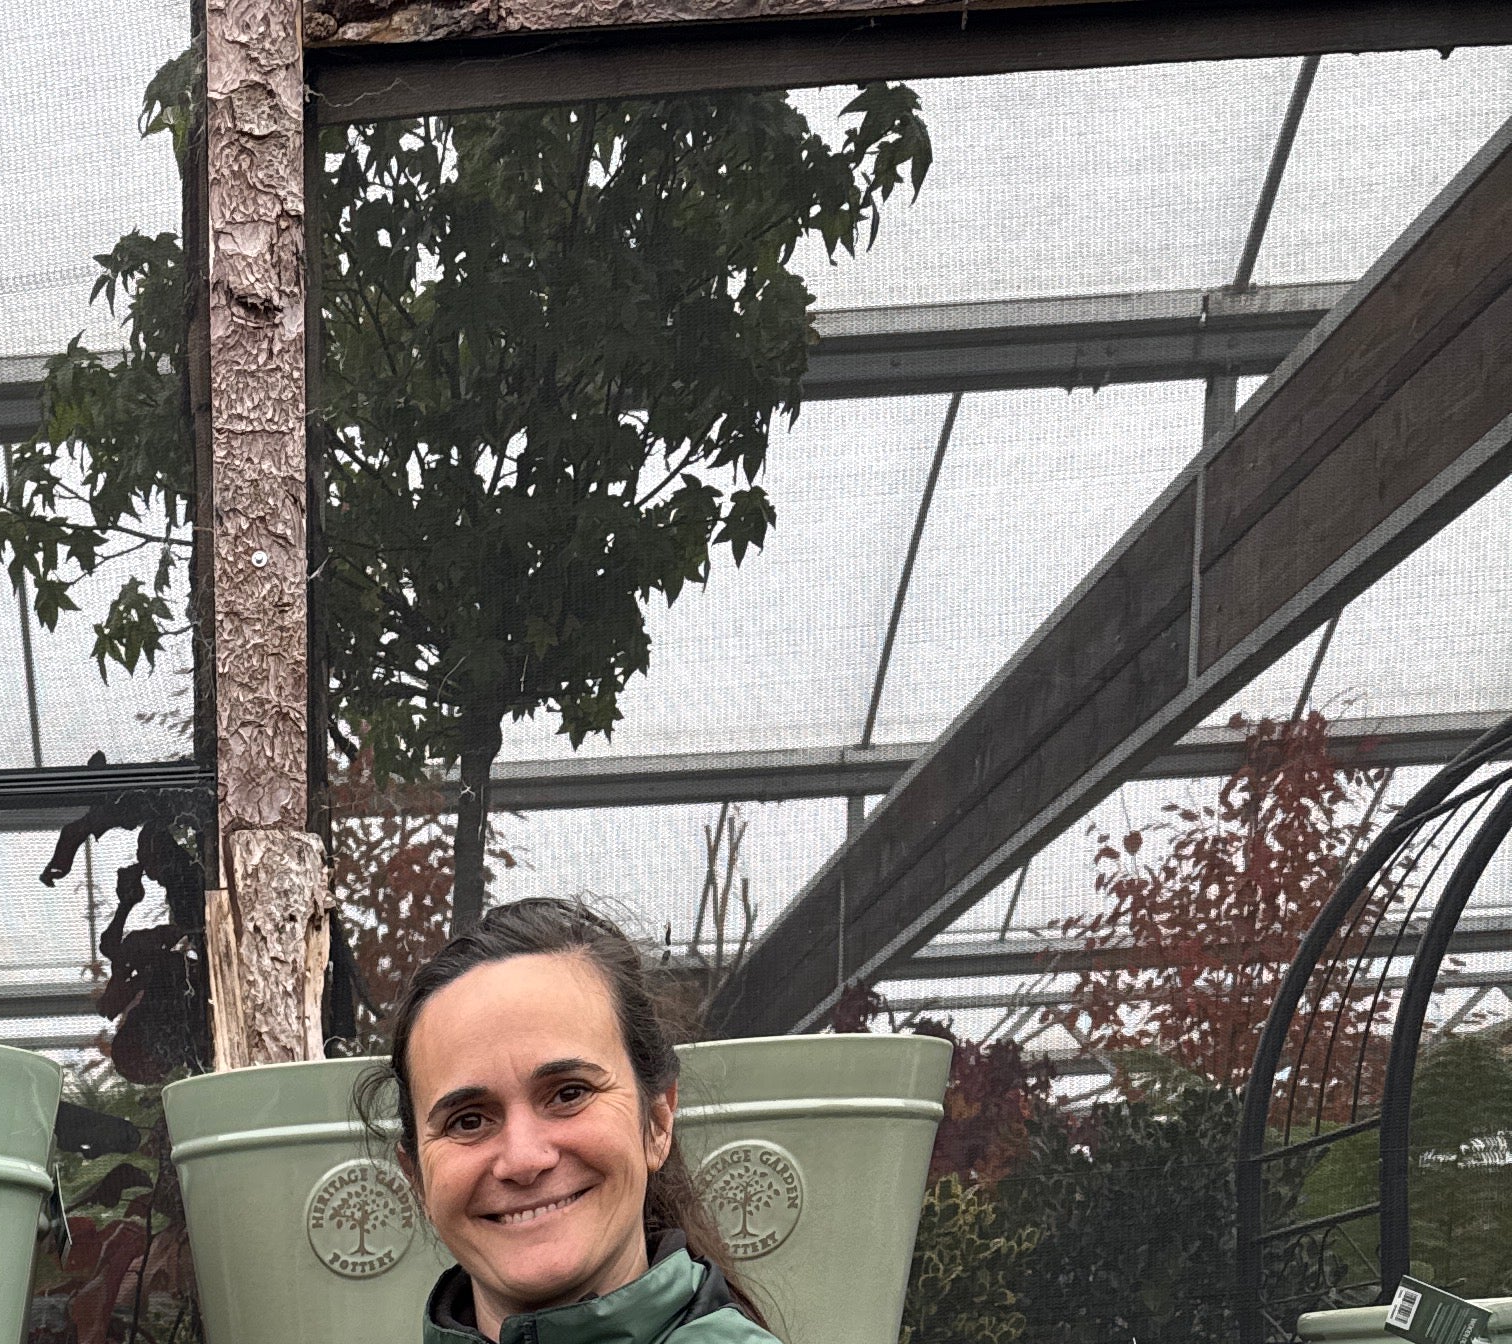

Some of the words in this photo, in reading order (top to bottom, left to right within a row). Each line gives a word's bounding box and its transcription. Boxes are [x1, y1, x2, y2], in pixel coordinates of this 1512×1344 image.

[311, 1167, 369, 1229] HERITAGE
[759, 1150, 799, 1209] GARDEN
[328, 1249, 395, 1273] POTTERY
